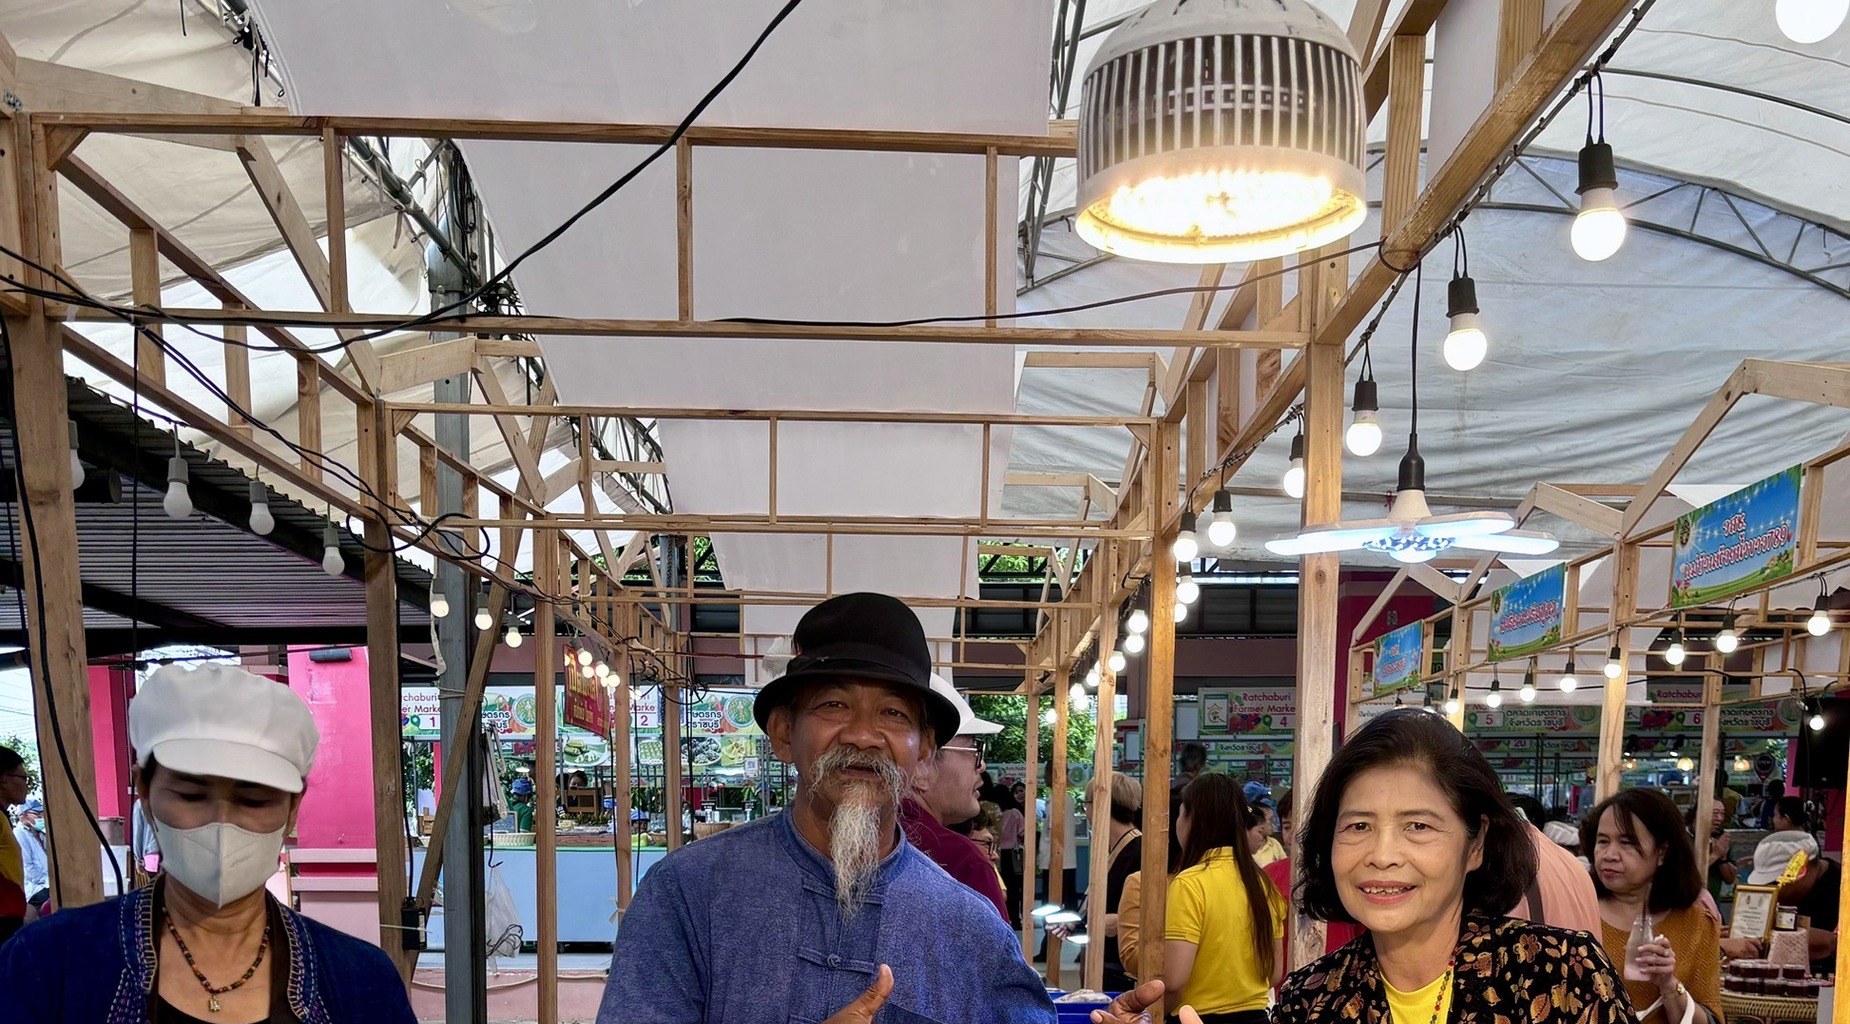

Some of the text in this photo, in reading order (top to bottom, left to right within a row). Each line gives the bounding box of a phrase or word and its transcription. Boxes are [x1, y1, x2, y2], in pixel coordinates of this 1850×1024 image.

[403, 692, 438, 702] chaburi
[1242, 692, 1291, 702] Ratchaburi
[1657, 690, 1703, 698] Ratchabur
[1233, 704, 1296, 713] Farmer Marke
[429, 716, 436, 728] 1
[640, 714, 648, 726] 2
[1279, 716, 1288, 727] 4
[1485, 714, 1493, 725] 5
[1693, 713, 1701, 724] 6
